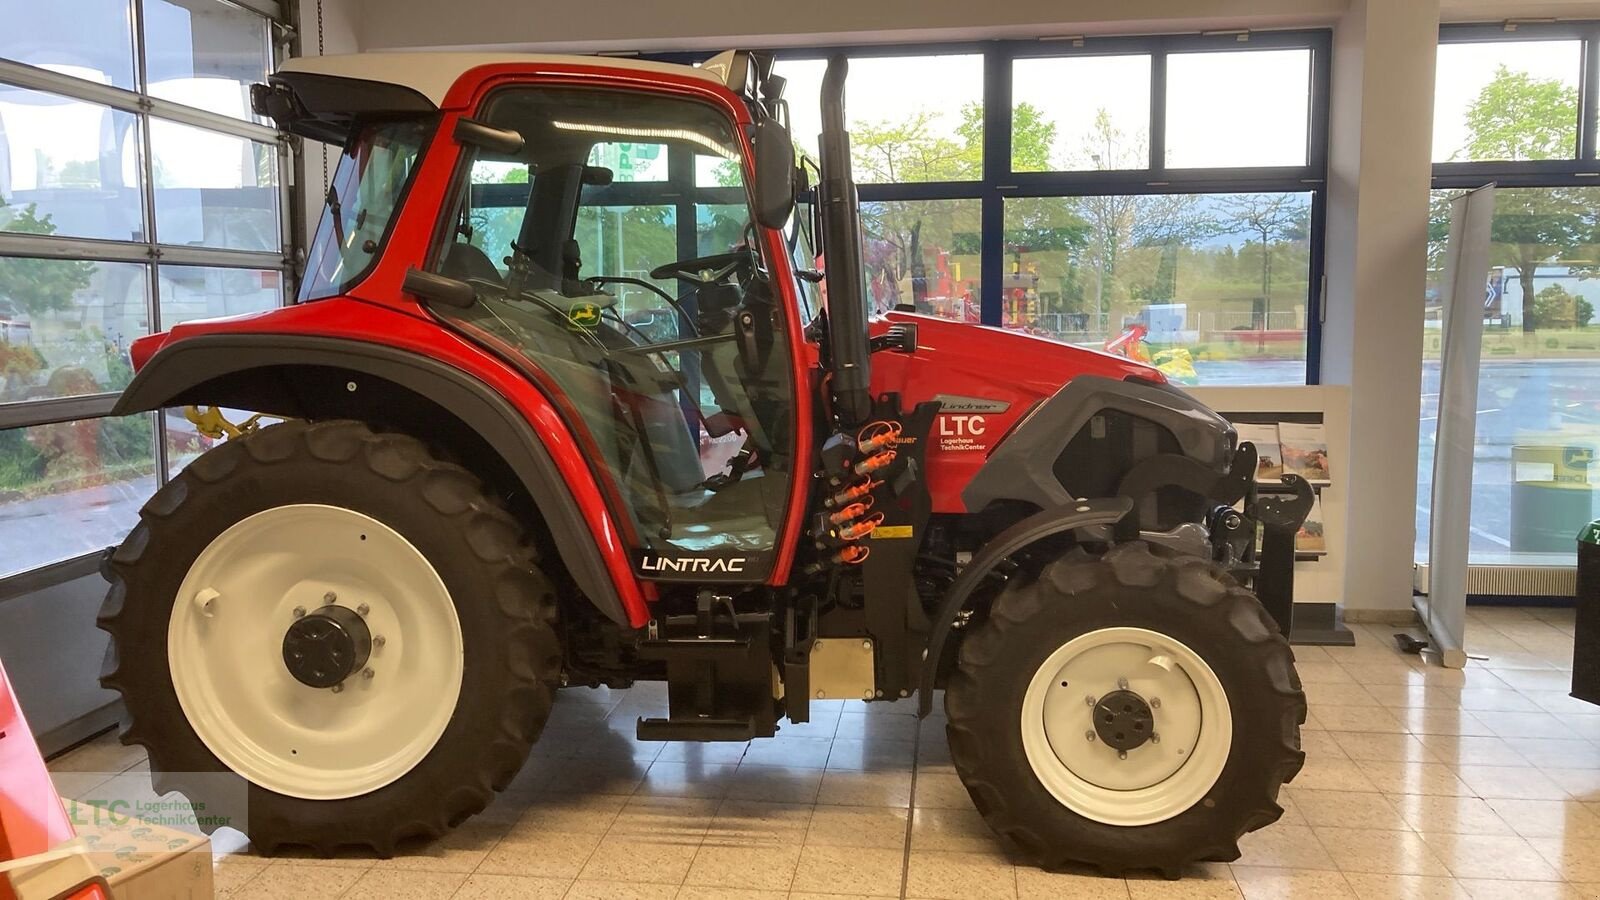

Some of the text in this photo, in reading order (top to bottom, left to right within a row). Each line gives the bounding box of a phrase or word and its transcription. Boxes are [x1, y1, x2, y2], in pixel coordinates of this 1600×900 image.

[941, 402, 997, 410] Lindner
[940, 415, 985, 436] LTC
[641, 556, 746, 572] LINTRAC
